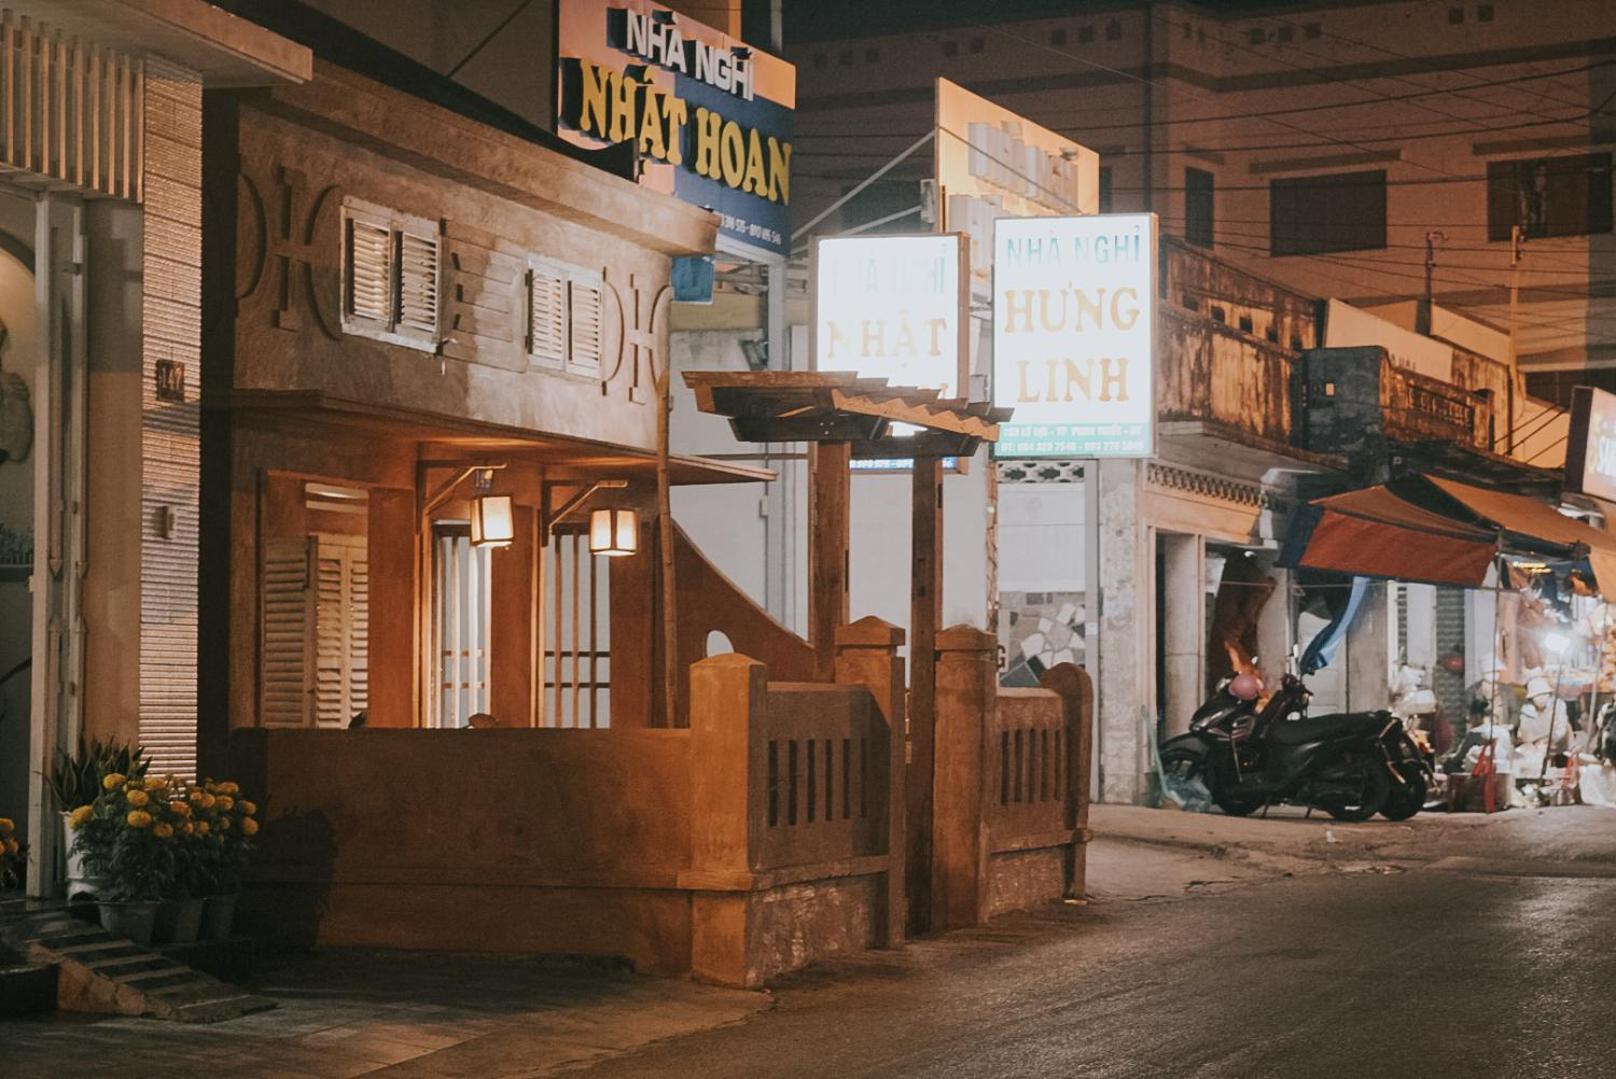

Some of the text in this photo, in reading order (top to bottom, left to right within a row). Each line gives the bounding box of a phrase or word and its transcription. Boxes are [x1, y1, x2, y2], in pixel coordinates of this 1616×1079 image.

[695, 106, 793, 207] HOAN
[1004, 281, 1140, 333] HƯNG
[1017, 358, 1130, 403] LINH
